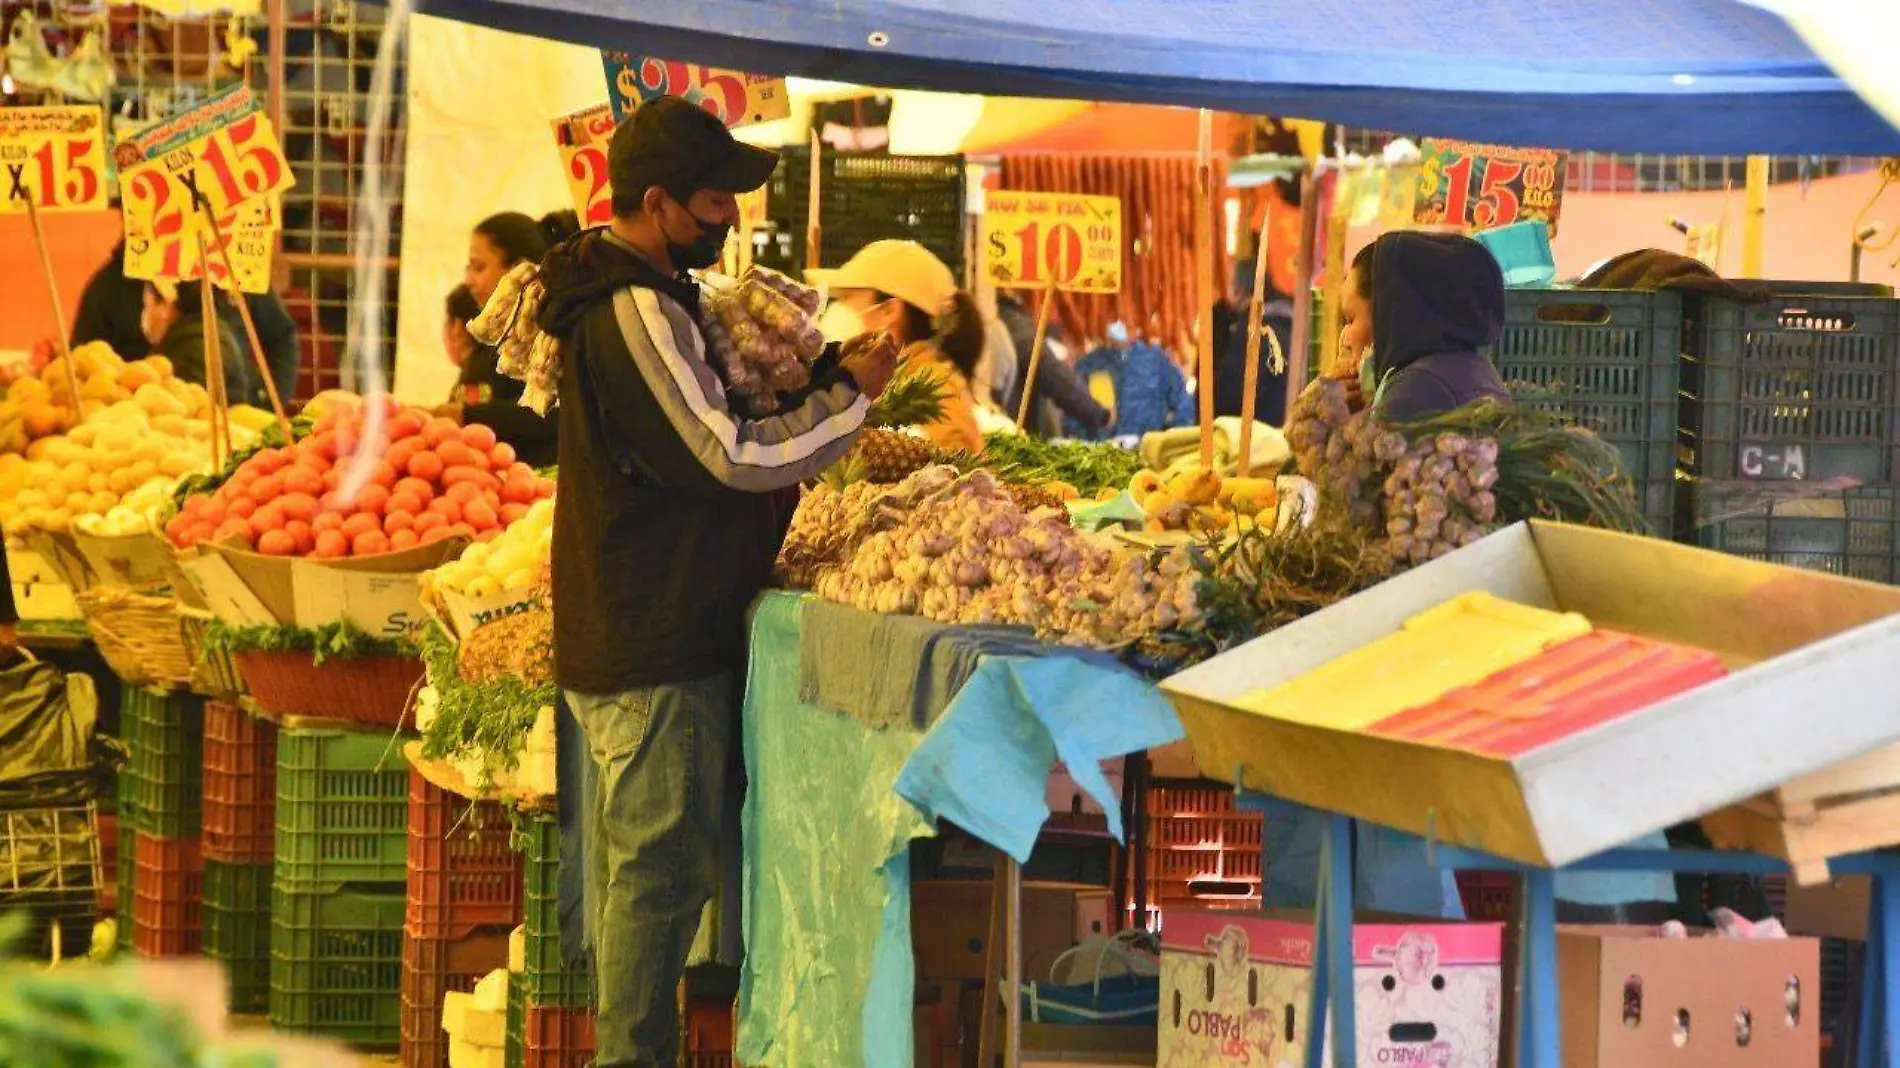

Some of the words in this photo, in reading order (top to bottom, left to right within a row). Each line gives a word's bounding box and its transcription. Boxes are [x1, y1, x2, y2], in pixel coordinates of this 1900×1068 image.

[31, 139, 98, 206] 15
[131, 169, 183, 239] 2
[201, 113, 283, 208] 15
[1443, 155, 1521, 226] 15
[988, 230, 1006, 258] $
[1014, 221, 1082, 283] 10
[1188, 1008, 1240, 1042] PABLO
